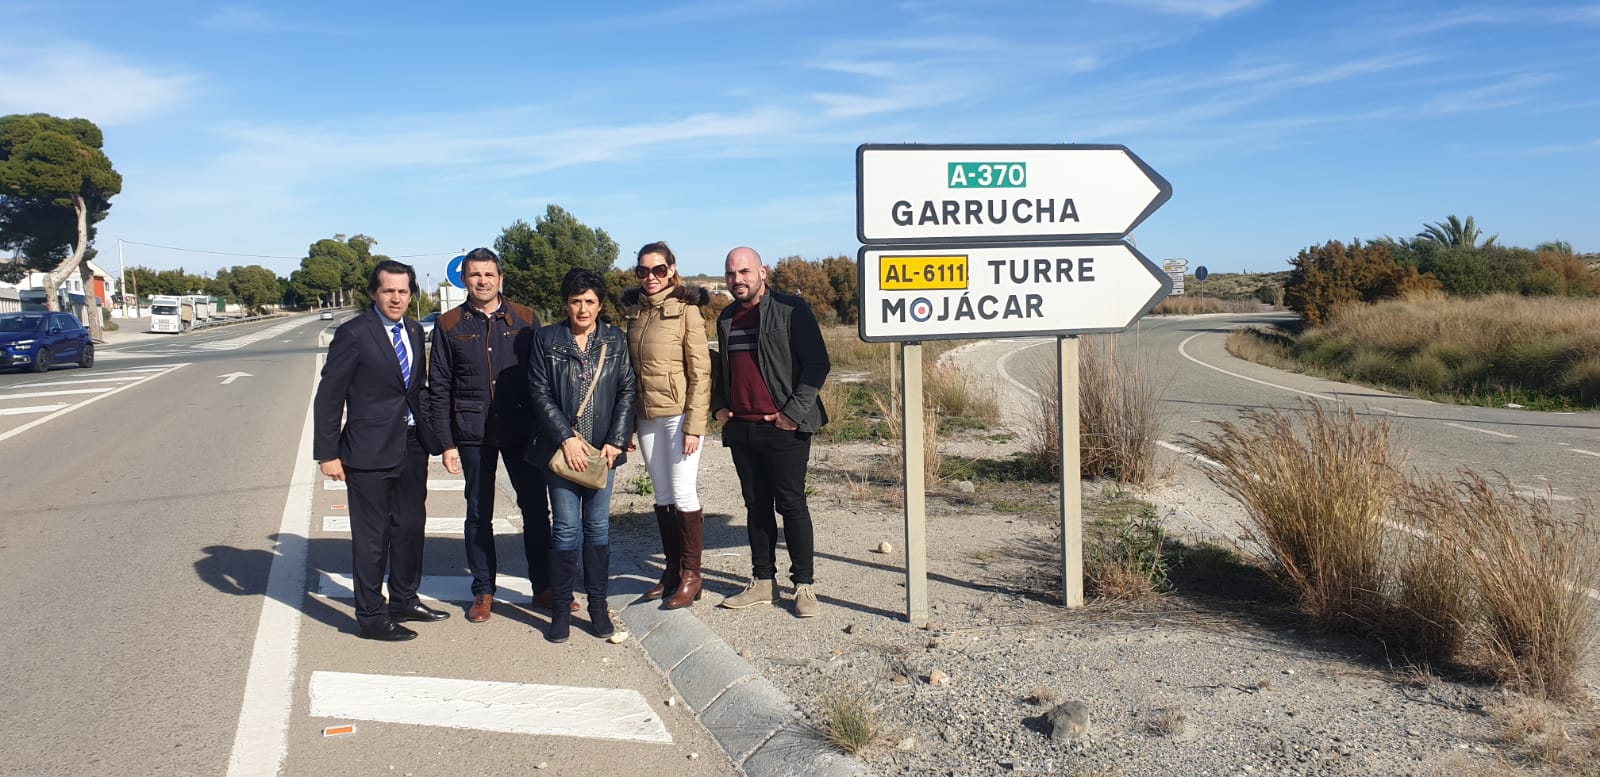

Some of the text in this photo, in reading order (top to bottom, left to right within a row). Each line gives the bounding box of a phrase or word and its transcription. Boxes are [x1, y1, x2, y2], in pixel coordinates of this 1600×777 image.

[950, 164, 1025, 186] A-370
[892, 198, 1080, 226] GARRUCHA
[884, 257, 1095, 284] AL-6111 TURRE
[881, 292, 1044, 324] MOJÁCAR
